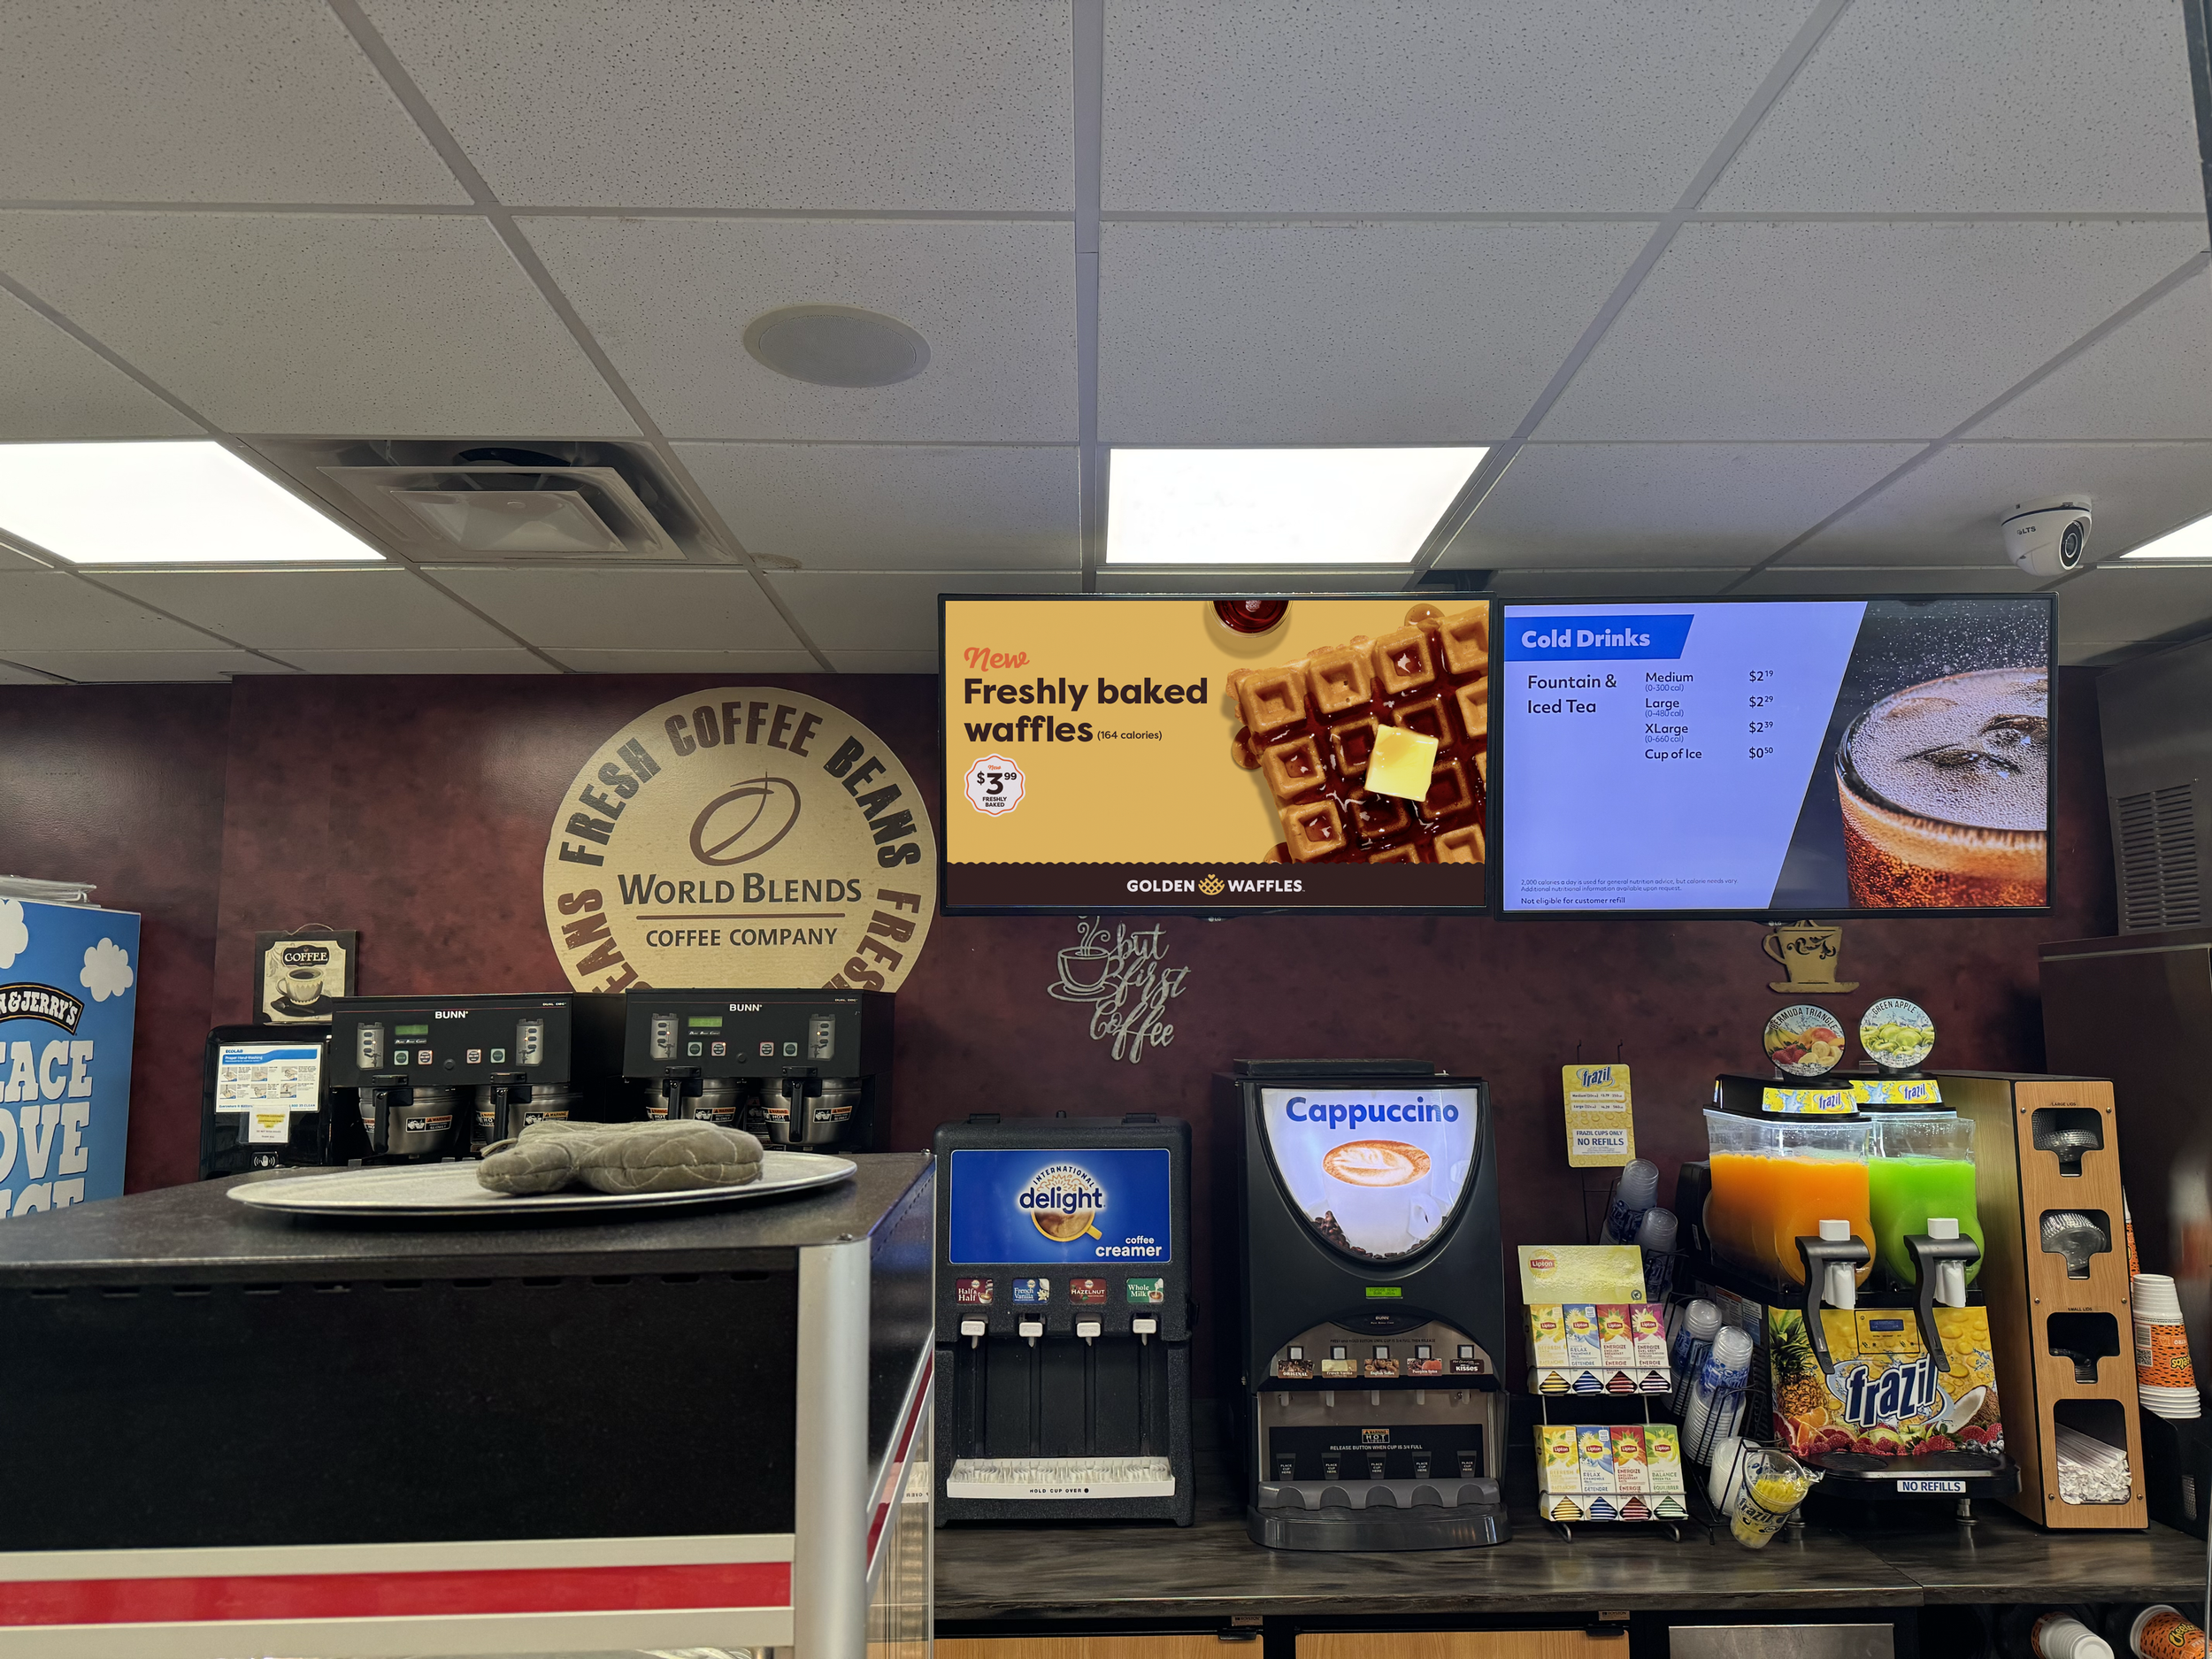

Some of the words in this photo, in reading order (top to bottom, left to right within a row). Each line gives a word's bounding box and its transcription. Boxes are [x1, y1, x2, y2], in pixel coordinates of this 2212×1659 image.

[2023, 526, 2037, 534] LTS
[1521, 629, 1571, 649] Cold
[1577, 627, 1651, 648] Drinks
[964, 647, 1030, 672] New
[1528, 674, 1601, 689] Fountain
[1604, 673, 1618, 688] &
[1645, 672, 1694, 683] Medium
[964, 677, 1089, 712] Freshly
[1097, 677, 1209, 705] baked
[1645, 684, 1670, 693] (0-300
[1671, 684, 1685, 693] cal)
[1528, 699, 1563, 714] Iced
[1566, 699, 1596, 713] Tea
[1645, 698, 1680, 711] Large
[1671, 710, 1685, 718] cal)
[664, 701, 823, 757] COFFEE
[964, 715, 1094, 742] waffles
[1097, 730, 1118, 741] (164
[1120, 730, 1164, 741] calories)
[1645, 724, 1689, 736] XLarge
[1645, 735, 1670, 744] (0-660
[1671, 735, 1685, 744] cal)
[1645, 749, 1669, 762] Cup
[1671, 749, 1685, 759] of
[1686, 749, 1702, 759] Ice
[558, 737, 662, 866] FRESH
[823, 735, 921, 868] BEANS
[618, 873, 734, 905] WORLD
[742, 872, 862, 903] BLENDS
[1126, 879, 1194, 893] GOLDEN
[1227, 879, 1302, 893] WAFFLES
[557, 888, 654, 993] EANS
[646, 929, 721, 948] COFFEE
[729, 927, 838, 947] COMPANY
[1116, 922, 1170, 960] but
[284, 952, 328, 962] COFFEE
[1115, 956, 1192, 1008] first
[434, 1010, 467, 1019] BUNN
[729, 1003, 761, 1012] BUNN
[1872, 1001, 1893, 1015] GREEN
[1894, 1001, 1917, 1014] APPLE
[1770, 1007, 1803, 1030] BERMUDA
[1805, 1007, 1839, 1031] TRIANGLE
[1582, 1066, 1611, 1087] frazil
[1818, 1092, 1842, 1111] frazil
[1903, 1082, 1926, 1102] frazil
[1286, 1096, 1459, 1130] Cappuccino
[1033, 1165, 1095, 1188] INTERNATIONAL
[1019, 1186, 1102, 1214] delight
[1125, 1235, 1155, 1245] coffee
[1095, 1244, 1162, 1257] creamer
[1532, 1260, 1554, 1269] Lipton
[1847, 1356, 1938, 1427] frazil
[1902, 1481, 1918, 1492] NO
[1921, 1481, 1961, 1492] REFILLS
